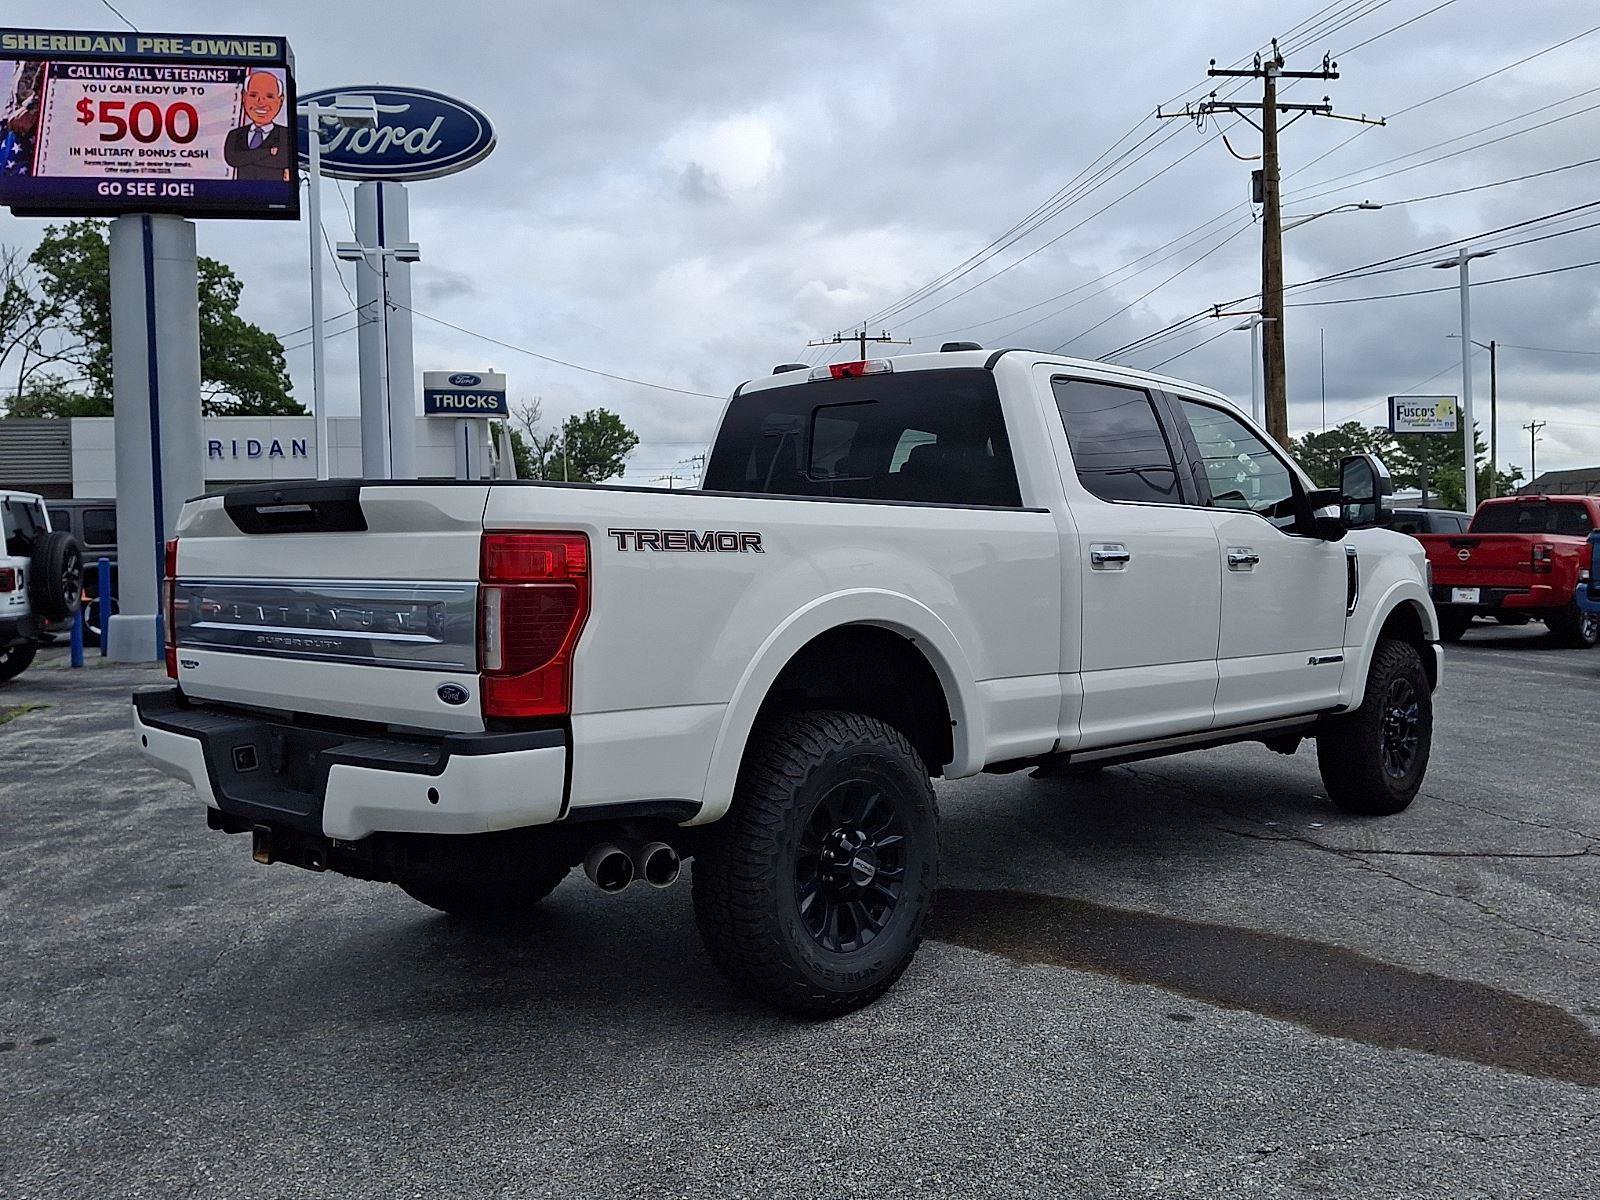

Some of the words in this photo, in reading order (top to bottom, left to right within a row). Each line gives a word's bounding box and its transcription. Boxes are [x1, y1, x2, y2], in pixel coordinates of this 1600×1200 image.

[2, 34, 126, 52] SHERIDAN
[137, 38, 277, 57] PRE-OWNED
[68, 66, 124, 78] CALLING
[128, 68, 150, 79] ALL
[155, 68, 229, 81] VETERANS!
[82, 84, 106, 93] YOU
[110, 84, 131, 94] CAN
[135, 85, 170, 95] ENJOY
[173, 86, 187, 95] UP
[190, 86, 205, 96] TO
[76, 97, 199, 144] $500
[320, 104, 446, 154] Ford
[69, 147, 80, 156] IN
[85, 148, 134, 157] MILITARY
[138, 149, 176, 158] BONUS
[180, 149, 209, 159] CASH
[97, 182, 122, 195] GO
[126, 183, 156, 195] SEE
[160, 183, 194, 196] JOE!
[433, 395, 499, 409] TRUCKS
[608, 528, 765, 553] TREMOR
[212, 604, 410, 628] PLATINUM
[442, 688, 460, 701] Ford
